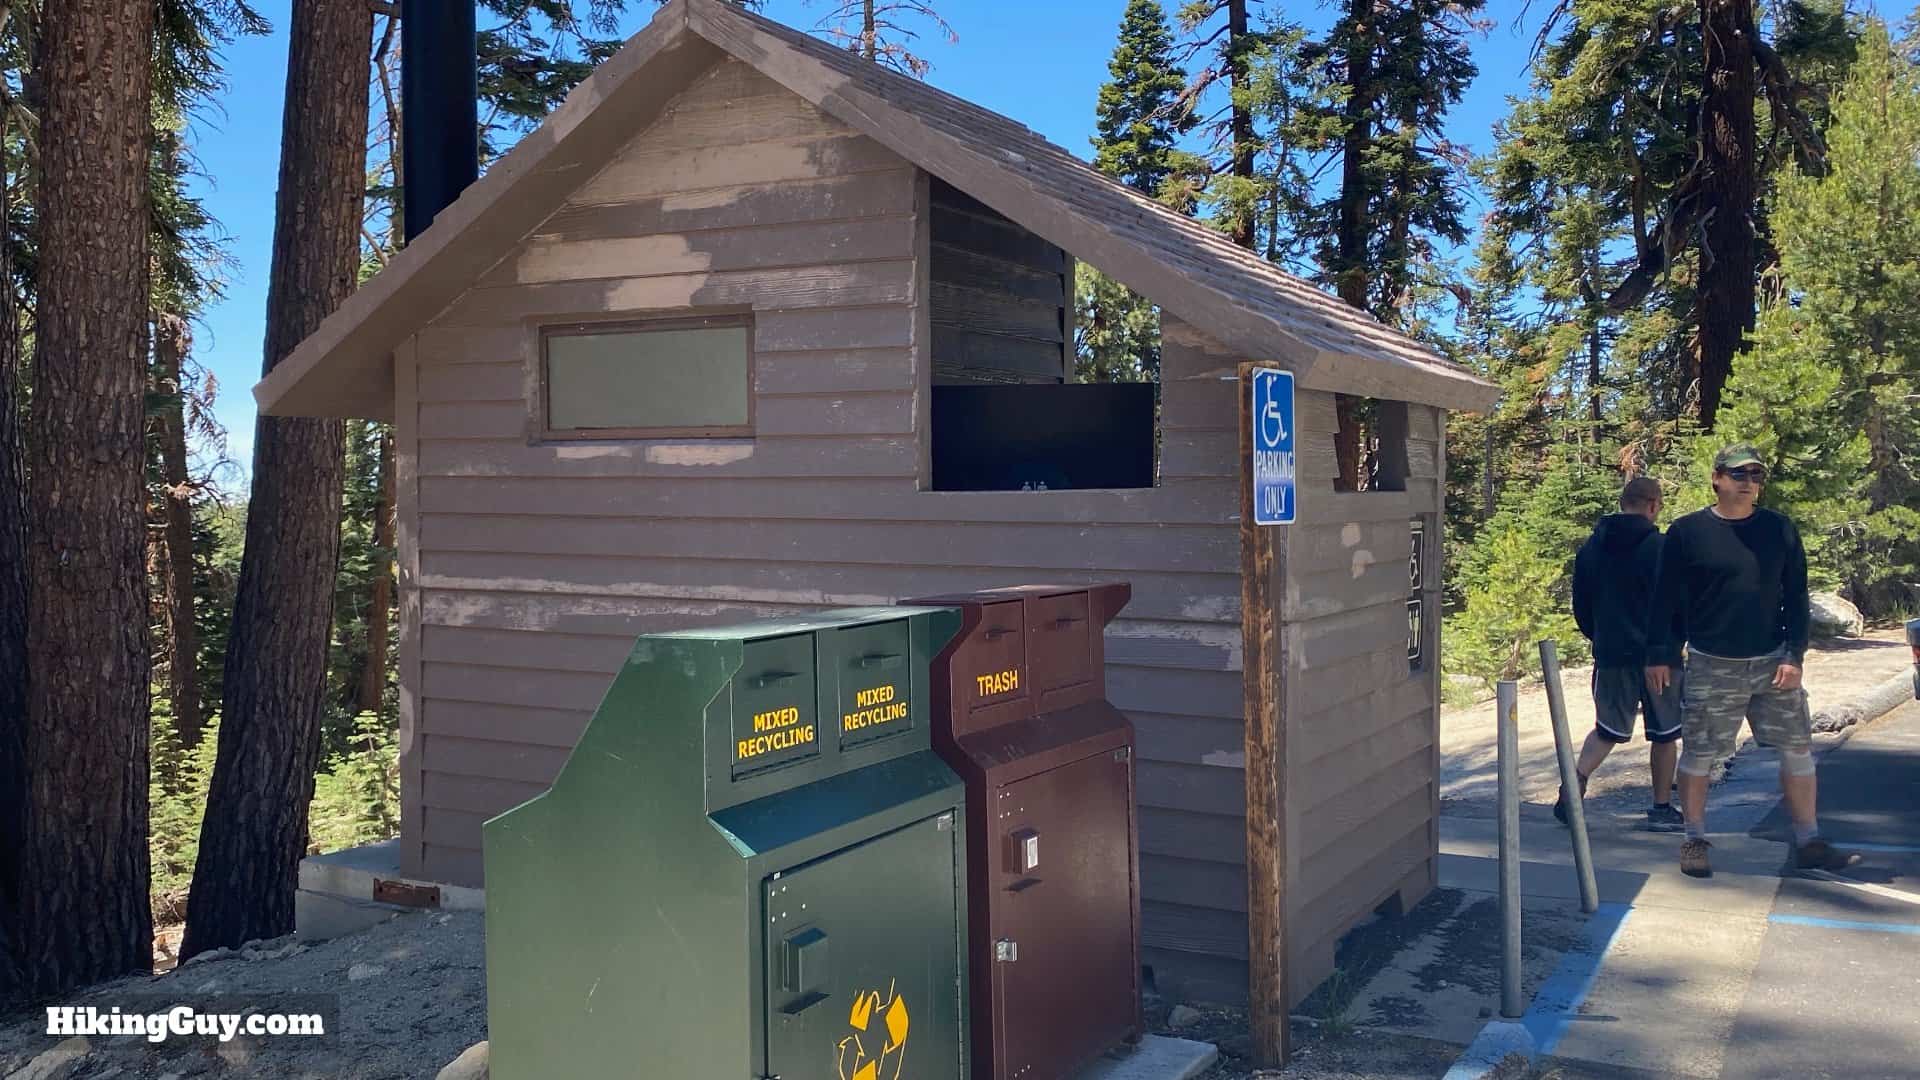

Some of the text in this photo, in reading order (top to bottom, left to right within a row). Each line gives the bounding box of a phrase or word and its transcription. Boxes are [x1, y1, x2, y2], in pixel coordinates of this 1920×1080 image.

[1256, 450, 1294, 478] PARKING
[1264, 486, 1287, 514] ONLY
[856, 685, 894, 708] MIXED
[977, 669, 1018, 697] TRASH
[753, 707, 799, 733] MIXED
[844, 702, 907, 731] RECYCLING
[738, 725, 814, 759] RECYCLING
